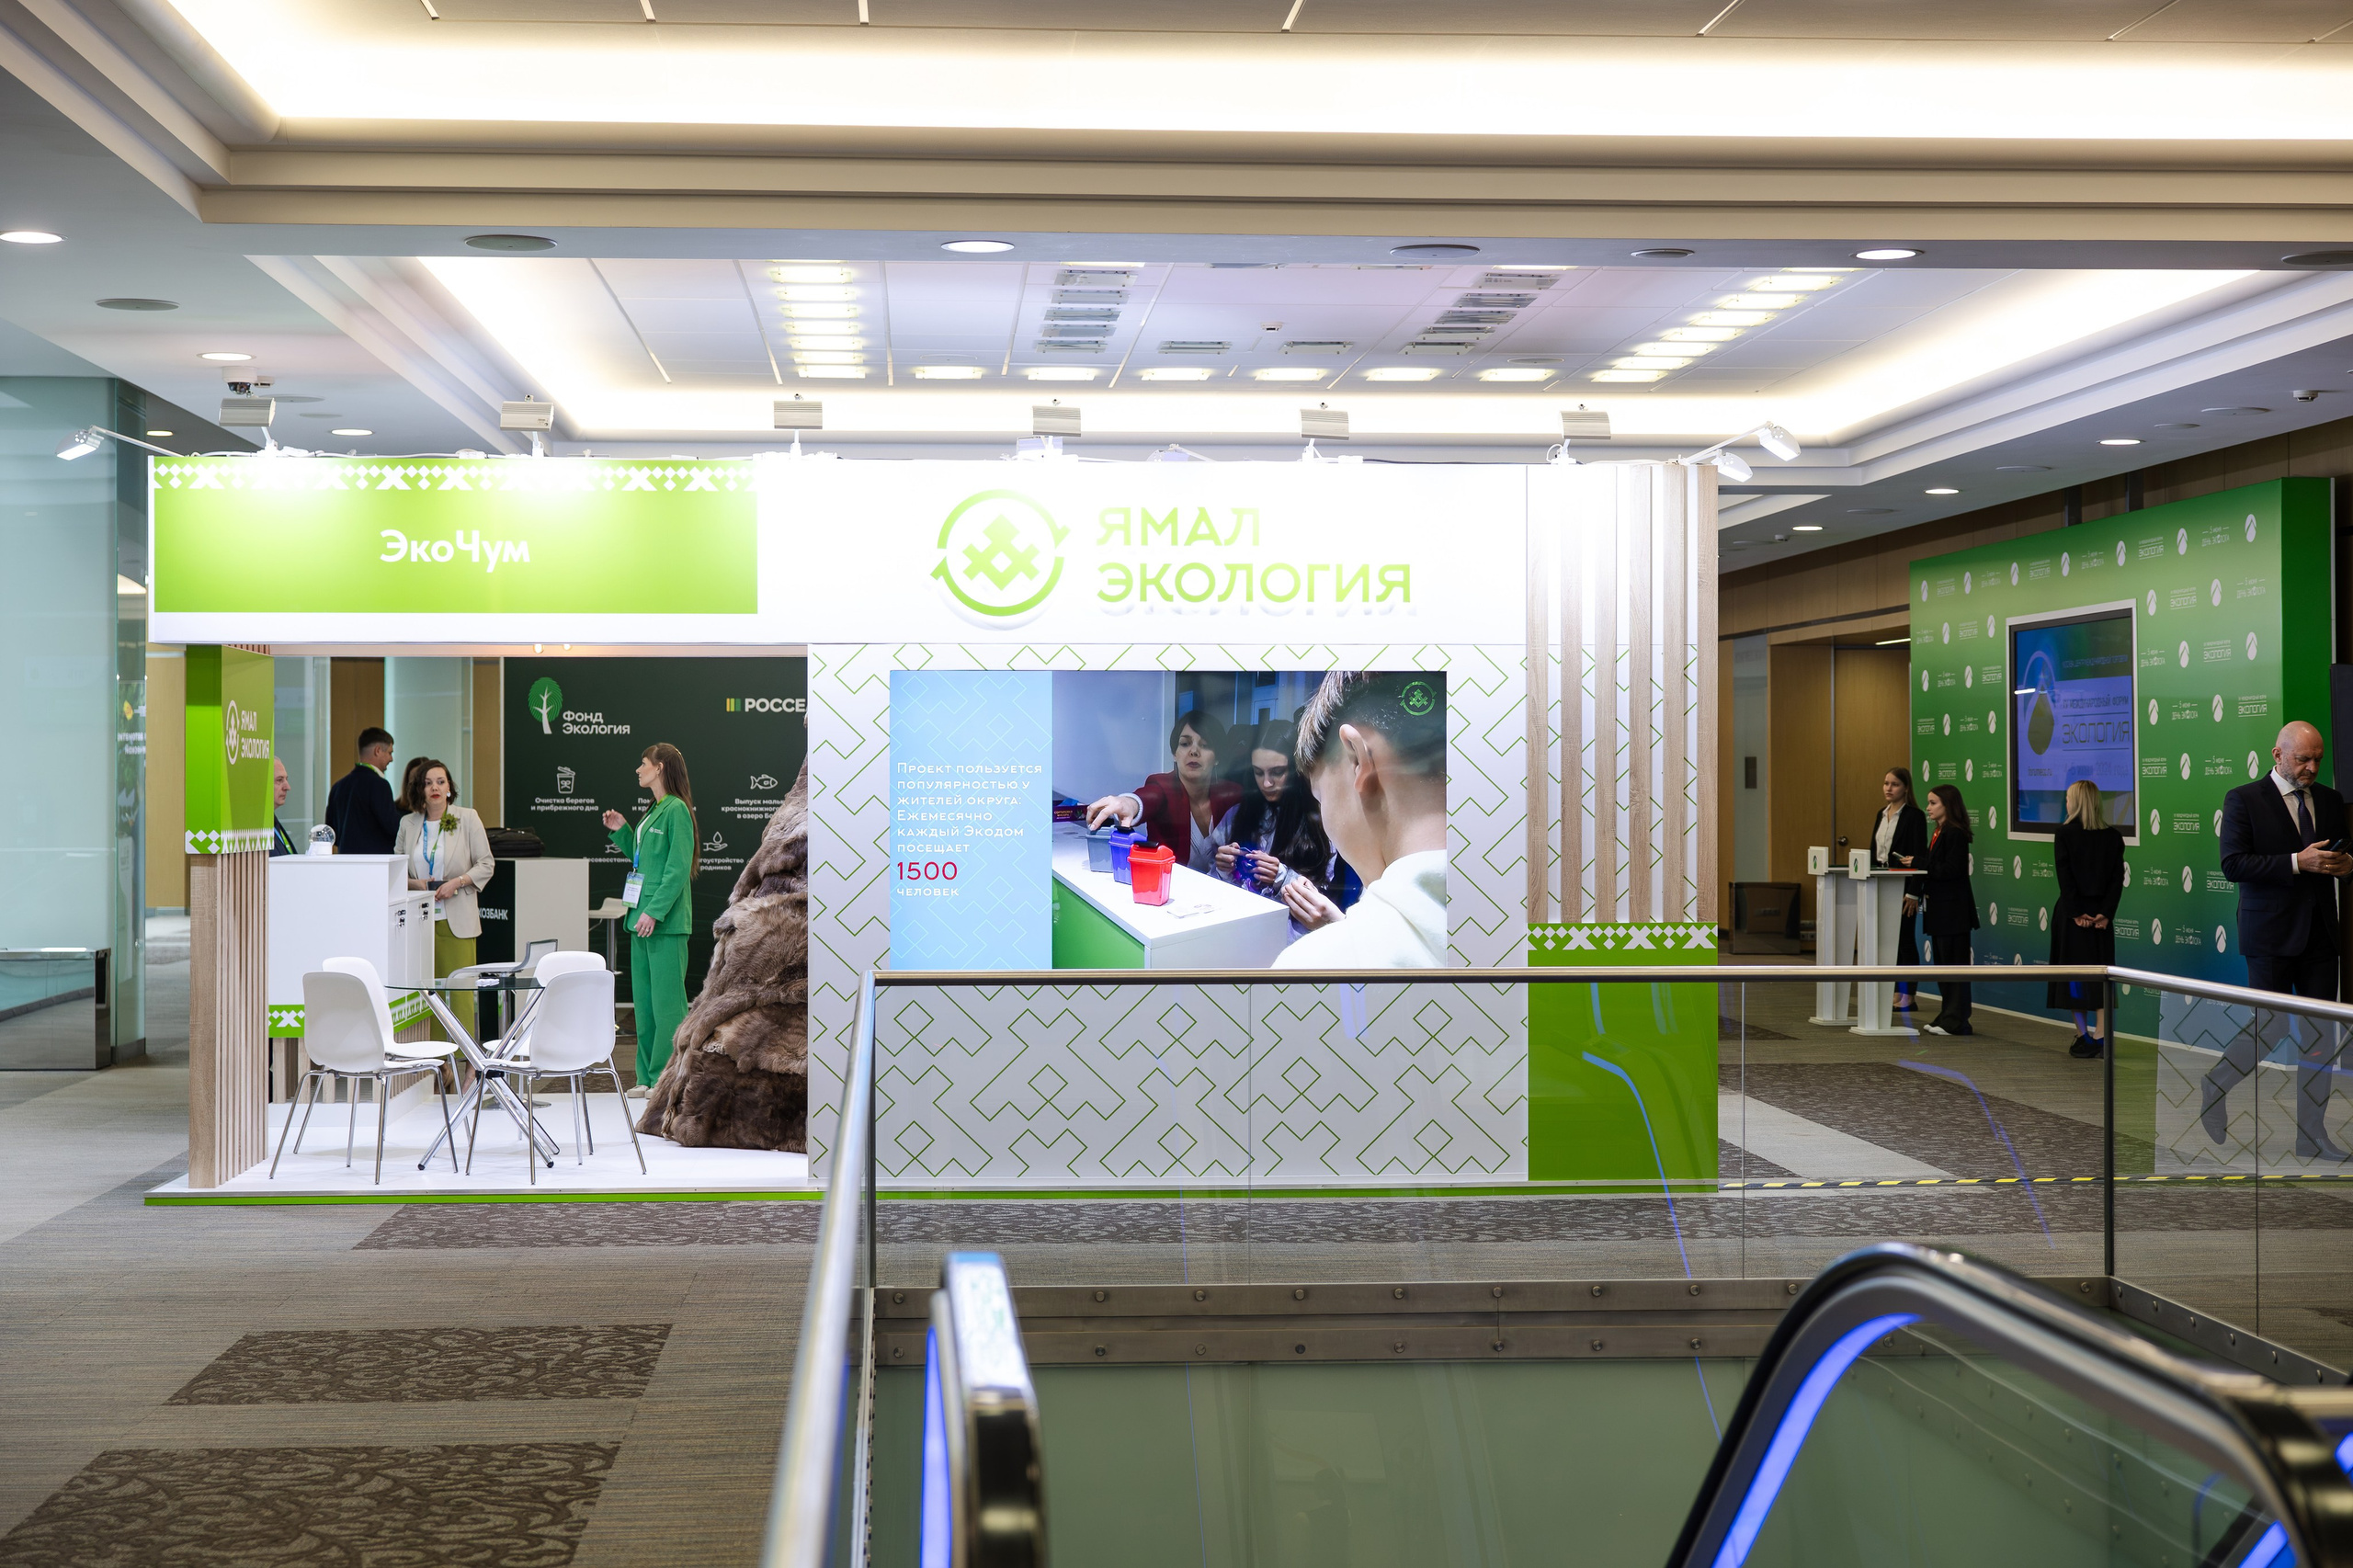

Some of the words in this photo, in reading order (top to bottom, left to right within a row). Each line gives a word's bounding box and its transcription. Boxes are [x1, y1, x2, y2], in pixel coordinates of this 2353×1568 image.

[1097, 506, 1260, 547] ЯМАЛ
[380, 528, 530, 573] ЭкоЧум
[1097, 562, 1411, 603] ЭКОЛОГИЯ
[745, 698, 807, 712] РОССЕ
[241, 710, 256, 732] ЯМАЛ
[563, 710, 604, 723] Фонд
[563, 722, 631, 735] Экология
[2062, 721, 2130, 744] ЭКОЛОГИЯ
[241, 737, 269, 759] ЭКОЛОГИЯ
[537, 804, 584, 812] прибрежного
[565, 797, 595, 805] берегов
[897, 861, 958, 881] 1500
